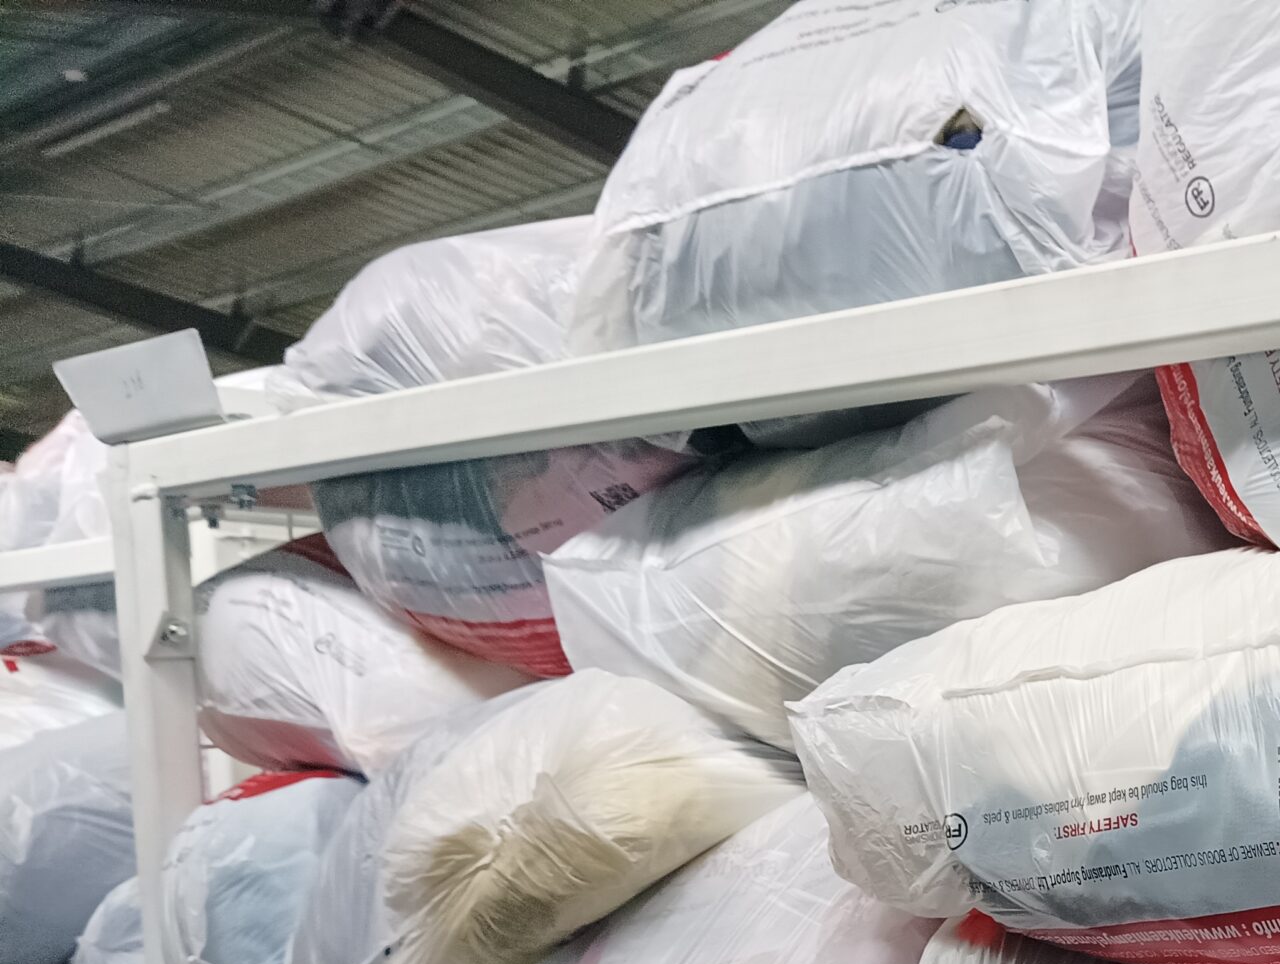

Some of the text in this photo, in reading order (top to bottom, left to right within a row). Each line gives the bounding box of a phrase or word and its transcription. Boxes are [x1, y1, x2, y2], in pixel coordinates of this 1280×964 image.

[1191, 182, 1210, 211] FR
[1141, 781, 1169, 800] should
[1170, 775, 1189, 791] bag
[1190, 774, 1208, 789] this
[1108, 789, 1127, 804] kept
[1128, 787, 1140, 801] be
[1004, 811, 1011, 824] &
[1088, 813, 1139, 836] SAFETY
[1198, 848, 1228, 867] BOGUS
[1228, 845, 1240, 862] OF
[1241, 841, 1277, 860] BEWARE
[1080, 863, 1129, 884] Fundraising
[1128, 861, 1141, 875] ALL
[1049, 870, 1082, 891] Support
